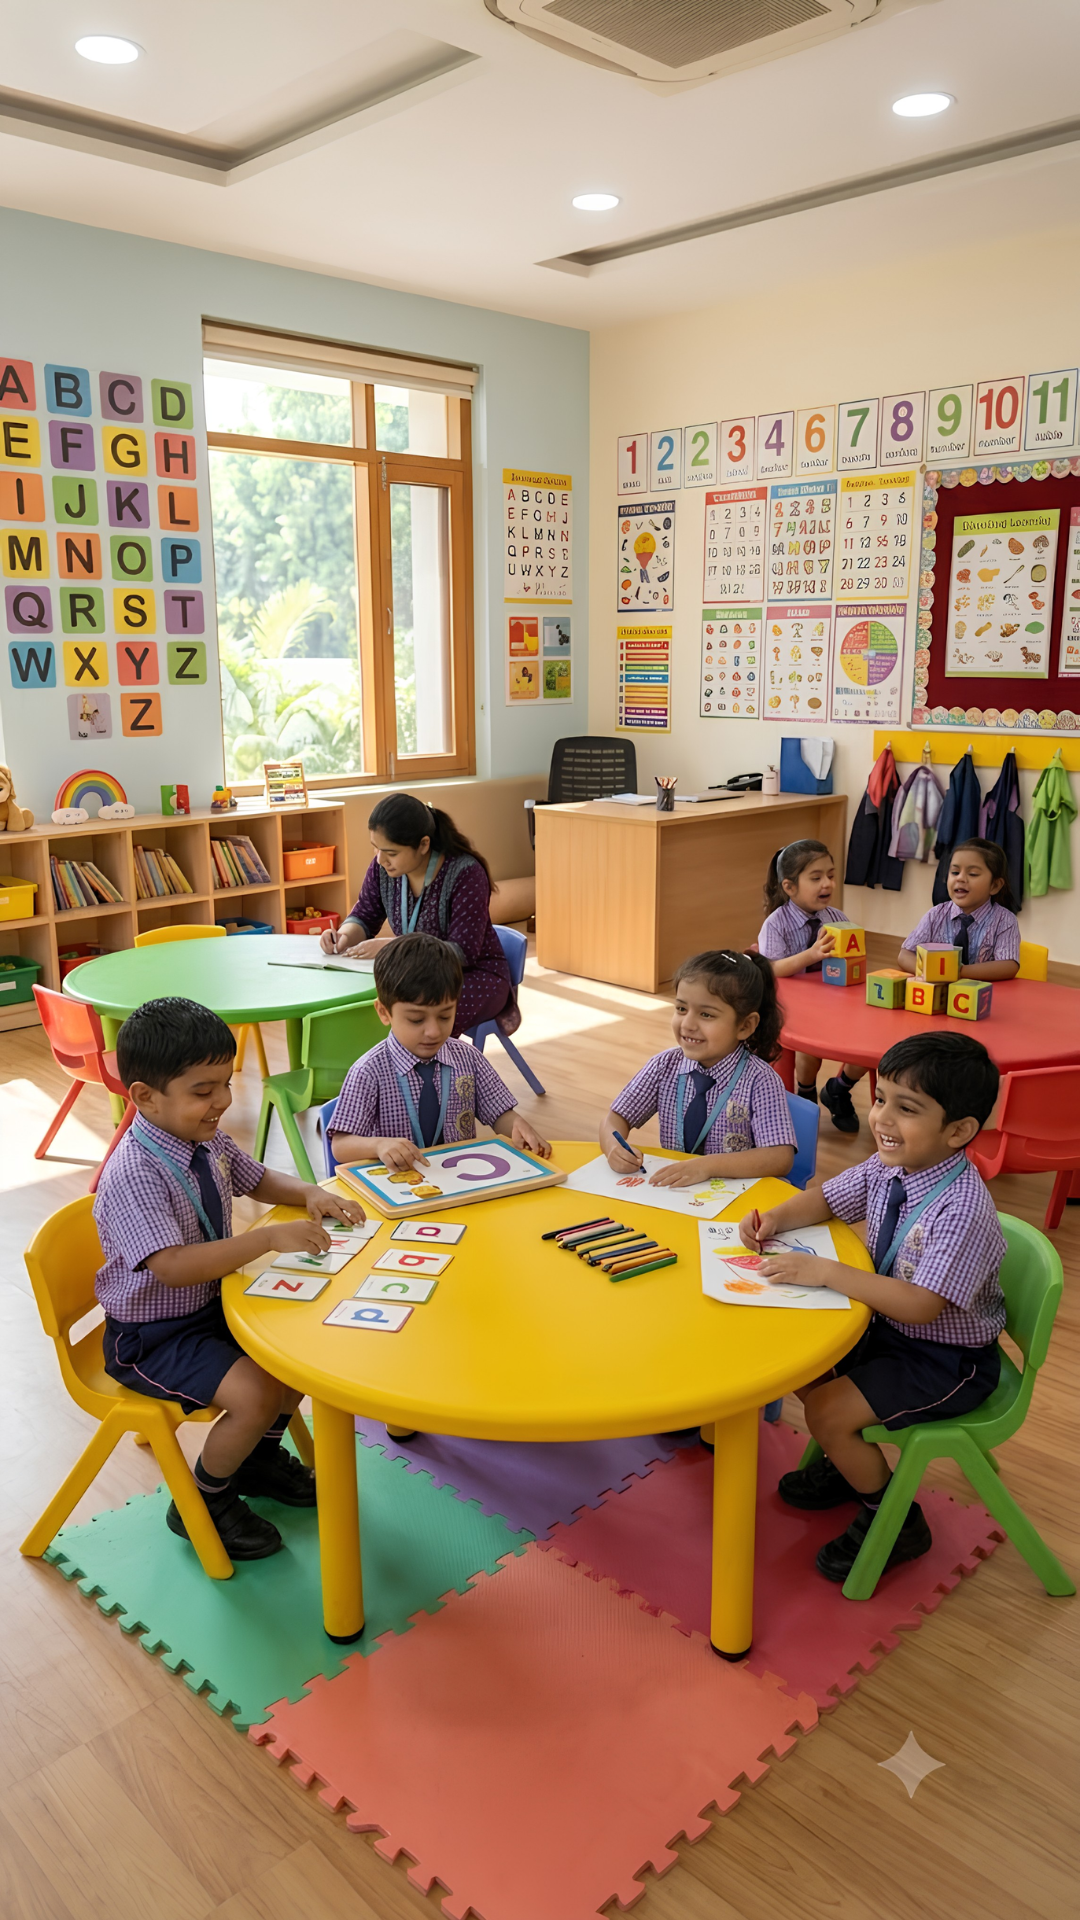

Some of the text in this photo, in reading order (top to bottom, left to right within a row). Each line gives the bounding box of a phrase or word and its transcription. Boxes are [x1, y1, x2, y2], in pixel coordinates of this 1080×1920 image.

[0, 365, 186, 421] A B C D
[626, 377, 1069, 474] 1 2 2 3 4 6 7 8 9 10 11
[3, 421, 189, 474] E F G H
[16, 478, 190, 526] I J K L
[508, 488, 516, 500] A
[522, 490, 530, 502] B
[535, 491, 542, 504] C
[562, 494, 568, 506] E
[848, 497, 852, 508] 1
[864, 494, 870, 507] 2
[882, 493, 888, 505] 3
[508, 507, 515, 520] E
[521, 509, 528, 520] F
[562, 512, 567, 524] J
[725, 508, 731, 519] 2
[740, 506, 746, 518] 3
[846, 518, 852, 529] 6
[863, 516, 870, 528] 7
[881, 514, 887, 526] 9
[508, 526, 515, 538] K
[522, 527, 528, 539] L
[561, 531, 568, 542] N
[725, 527, 731, 539] 7
[522, 546, 529, 557] P
[536, 547, 543, 558] R
[549, 548, 555, 559] S
[844, 538, 853, 549] 11
[8, 535, 193, 577] M N O P
[857, 557, 870, 569] 22
[875, 556, 888, 568] 23
[892, 555, 905, 567] 24
[508, 564, 568, 578] U W X Y Z
[13, 592, 195, 628] Q R S T
[12, 646, 200, 682] W X Y Z
[130, 698, 155, 731] Z
[846, 933, 860, 953] A
[912, 987, 925, 1005] B
[953, 993, 970, 1013] C
